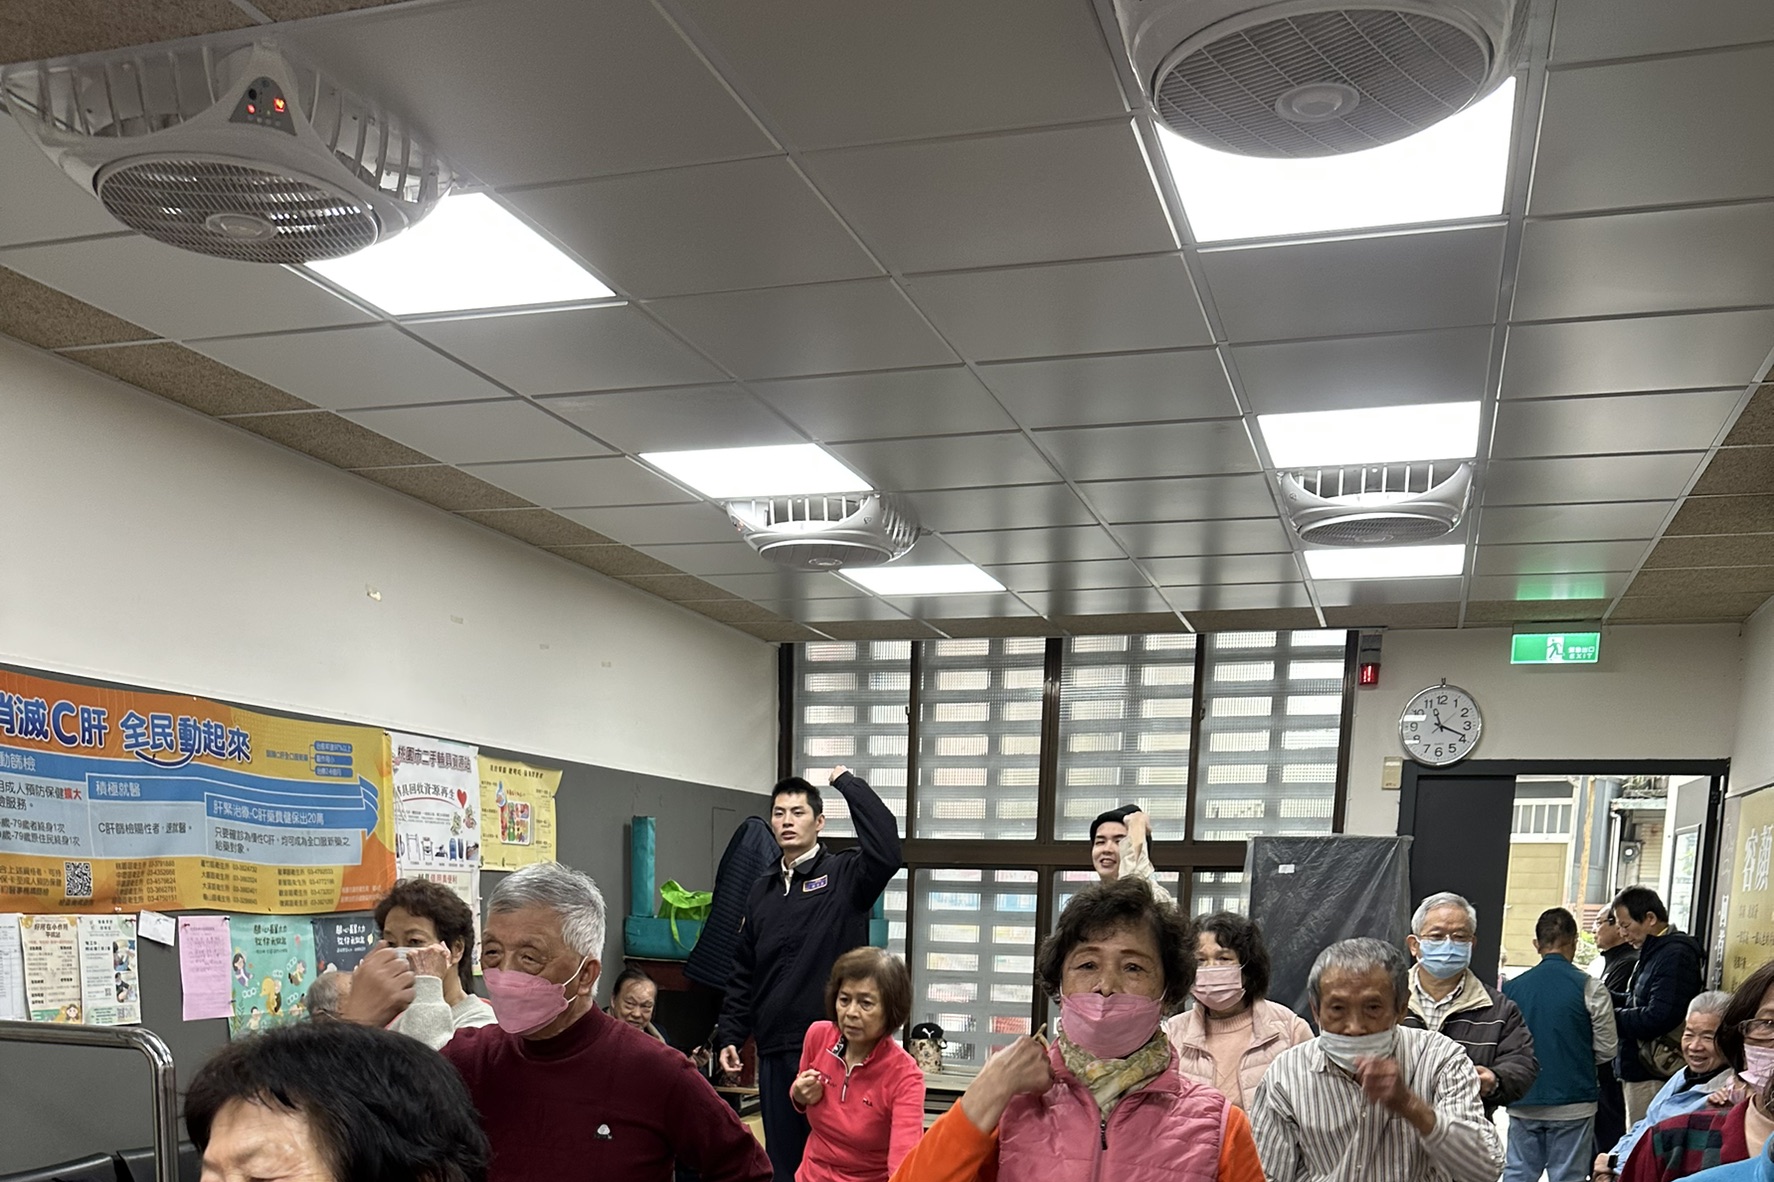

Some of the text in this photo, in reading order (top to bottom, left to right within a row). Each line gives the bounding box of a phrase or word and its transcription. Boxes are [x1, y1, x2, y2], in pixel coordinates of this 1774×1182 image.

[1424, 699, 1433, 709] 11
[1436, 695, 1448, 705] 12
[1460, 707, 1470, 718] 2
[1410, 722, 1418, 732] 9
[1463, 721, 1472, 731] 3
[119, 709, 252, 768] 全民動起來
[1458, 734, 1467, 744] 4
[1423, 744, 1431, 754] 7
[1434, 747, 1443, 757] 6
[1448, 743, 1457, 753] 5
